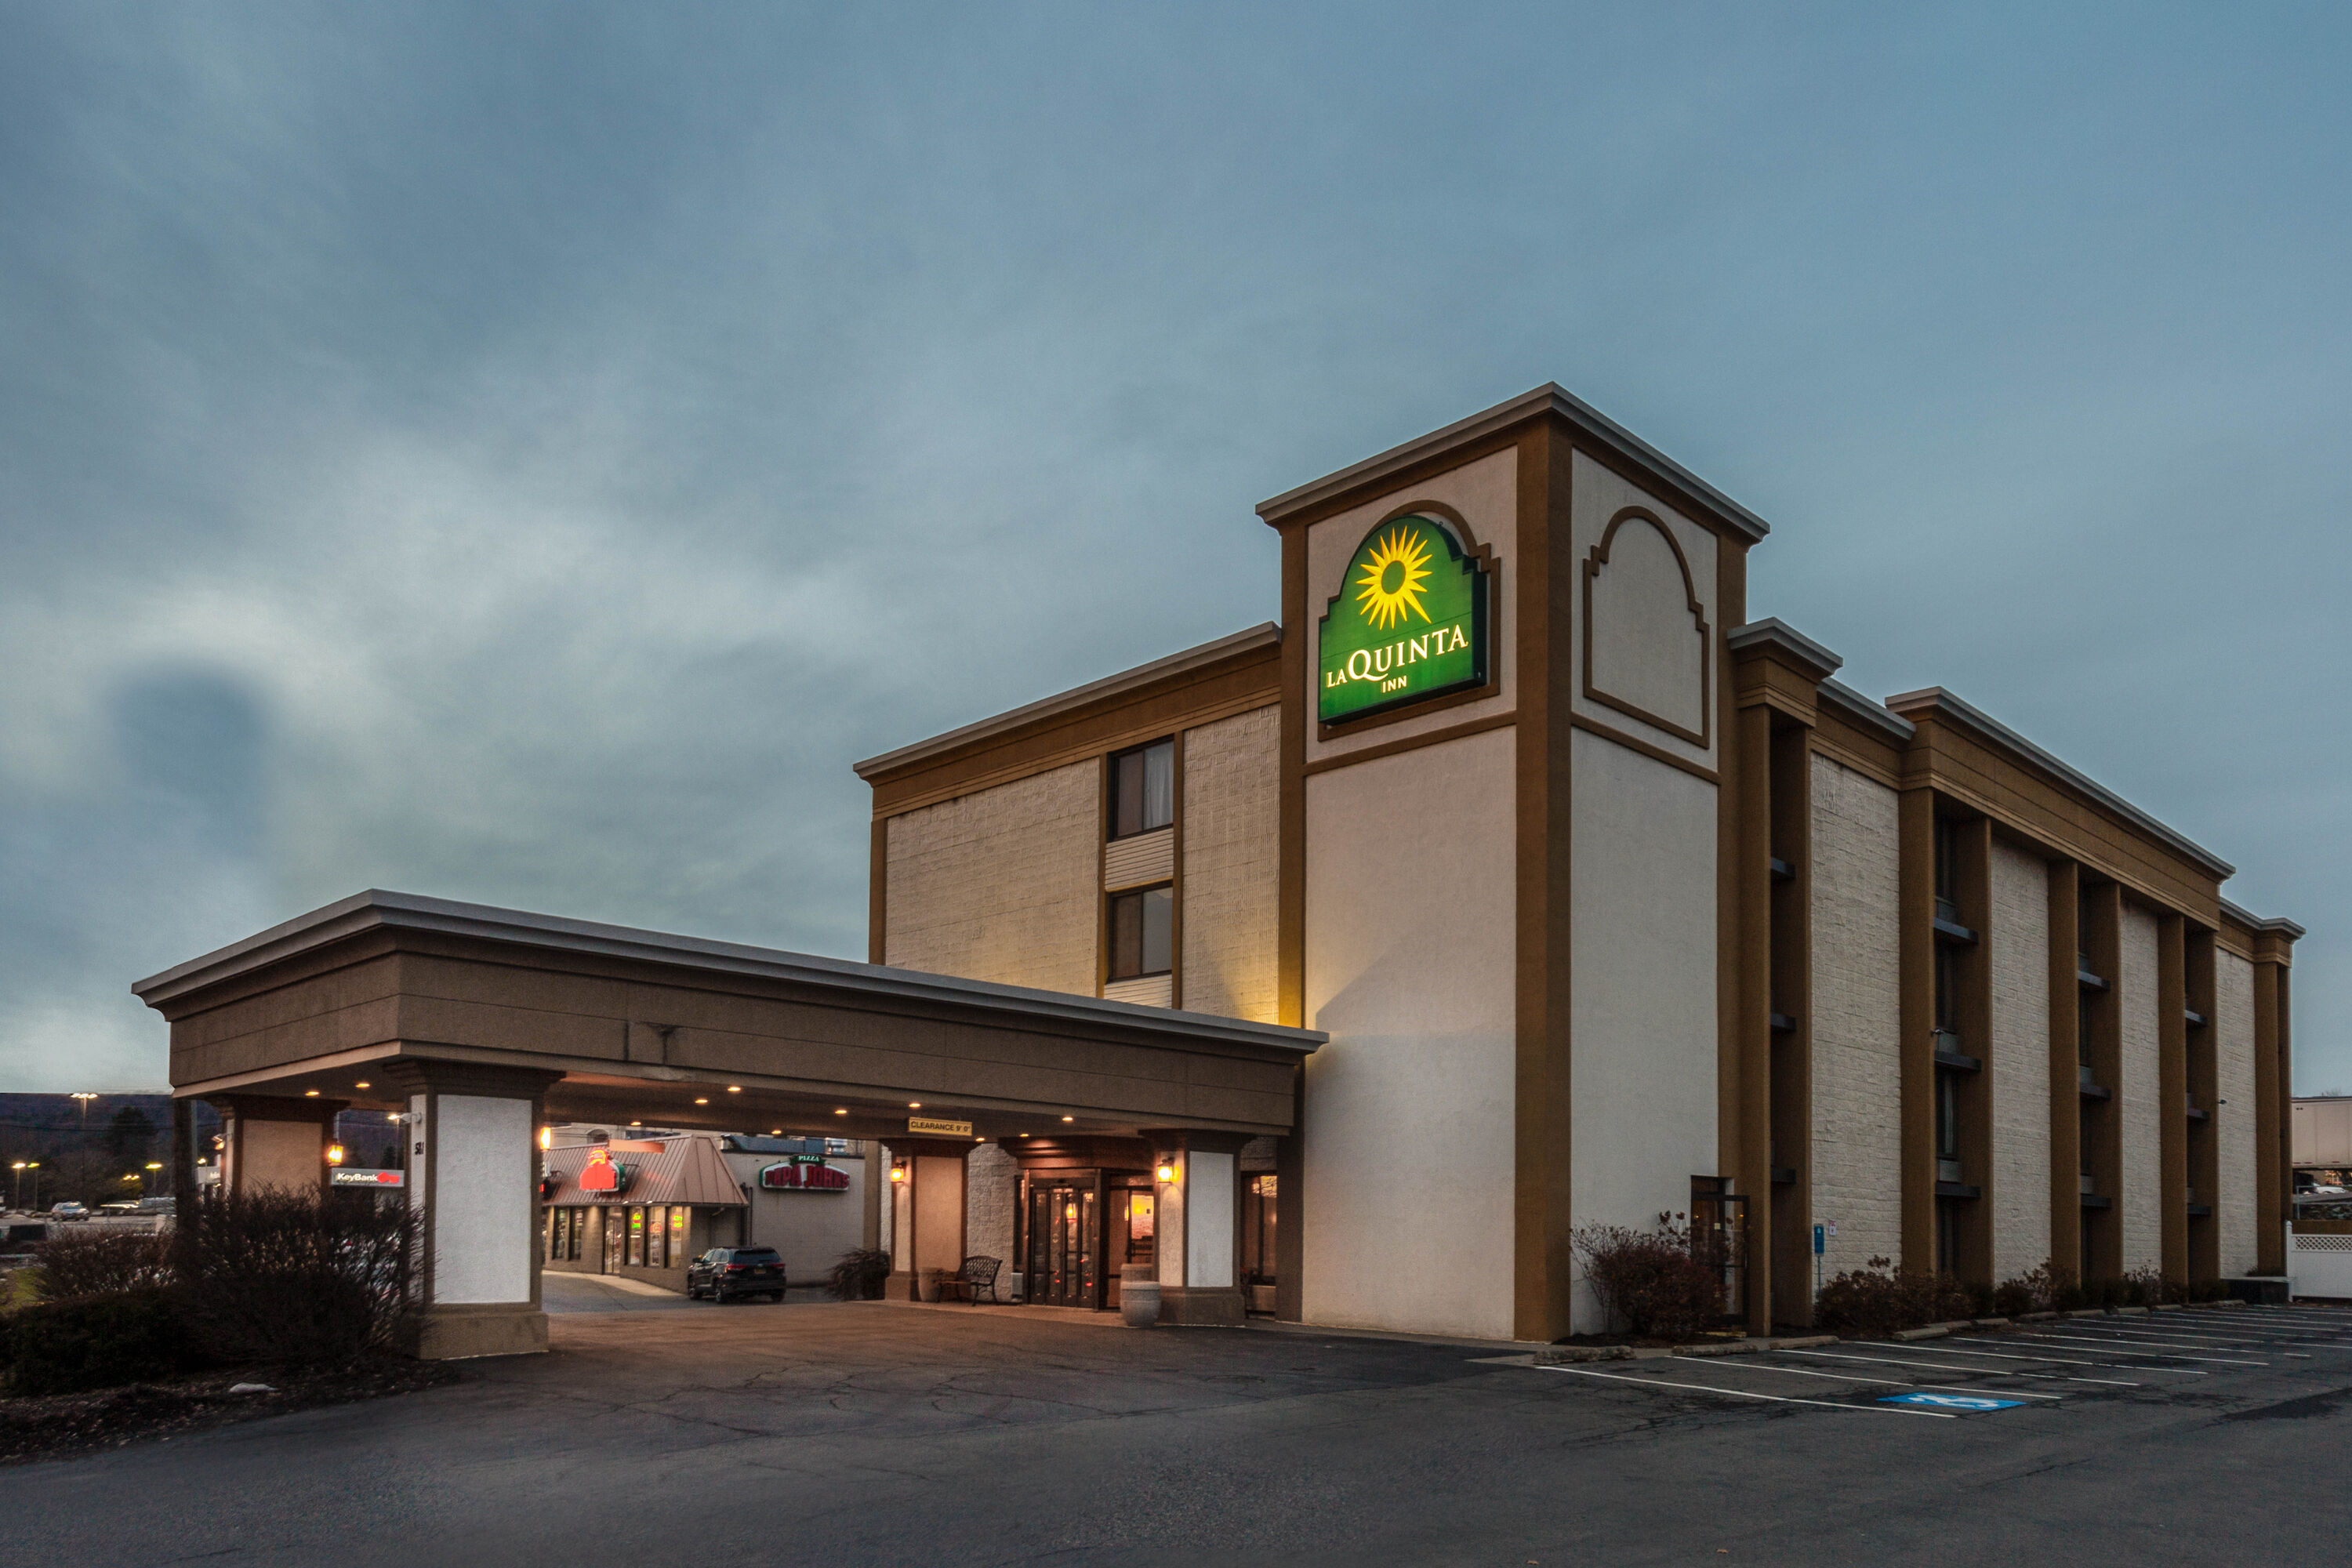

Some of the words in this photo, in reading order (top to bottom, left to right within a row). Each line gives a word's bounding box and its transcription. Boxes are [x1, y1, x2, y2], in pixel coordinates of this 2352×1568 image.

[1327, 668, 1348, 688] LA
[1347, 624, 1469, 682] QUINTA
[1382, 675, 1407, 694] INN
[910, 1121, 955, 1131] CLEARANCE
[336, 1172, 378, 1182] KeyBank
[765, 1165, 802, 1187] PAPA
